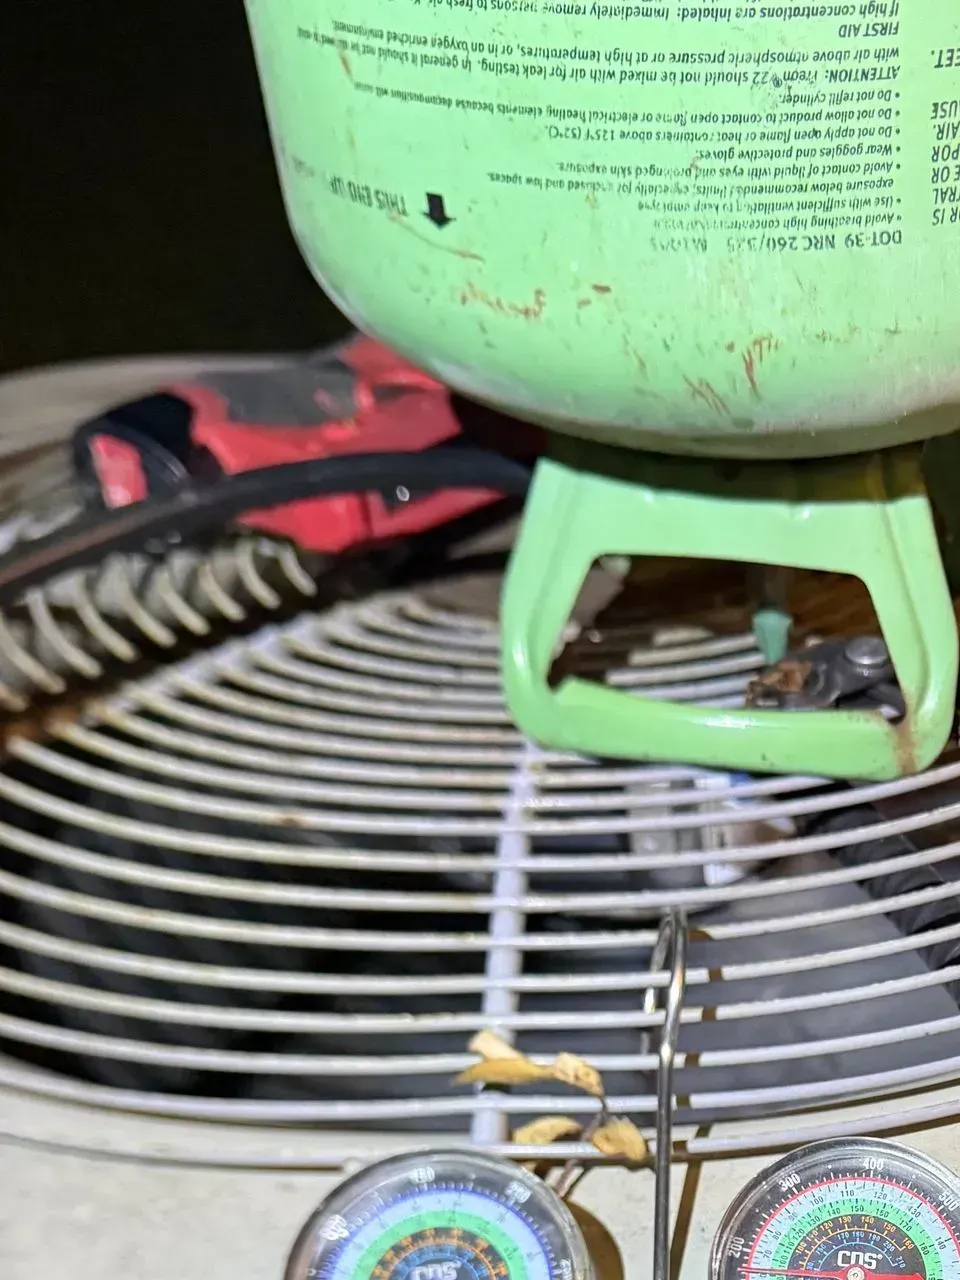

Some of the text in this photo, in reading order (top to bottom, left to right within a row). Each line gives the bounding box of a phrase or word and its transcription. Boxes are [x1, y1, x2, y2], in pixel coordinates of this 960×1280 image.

[589, 0, 888, 22] high concentrations inhaled: Immediately
[838, 21, 900, 38] FIRST AID
[386, 30, 900, 68] with air above atmospheric pressure high temperatures, oxygen enriched
[420, 53, 900, 86] ATTENTION: should mixed with leak testing. general
[778, 90, 892, 107] Do not refill cylinder.
[546, 104, 892, 126] Do not allow product contact electrical heating
[619, 130, 653, 142] above
[794, 127, 821, 142] open
[824, 126, 855, 142] apply
[858, 128, 875, 140] not
[878, 126, 892, 138] Do
[932, 122, 960, 140] AIR.
[738, 142, 892, 162] Wear goggles and protective
[719, 161, 894, 178] Avoid contact eyes
[931, 166, 950, 184] OR
[811, 178, 894, 196] exposure below
[796, 198, 871, 214] with sufficient
[810, 214, 862, 230] breathing
[932, 208, 946, 226] IS
[802, 230, 902, 250] DOT-39 NRC
[863, 1157, 885, 1171] 400
[779, 1173, 801, 1192] 300
[938, 1191, 960, 1212] 500
[729, 1237, 745, 1259] 200
